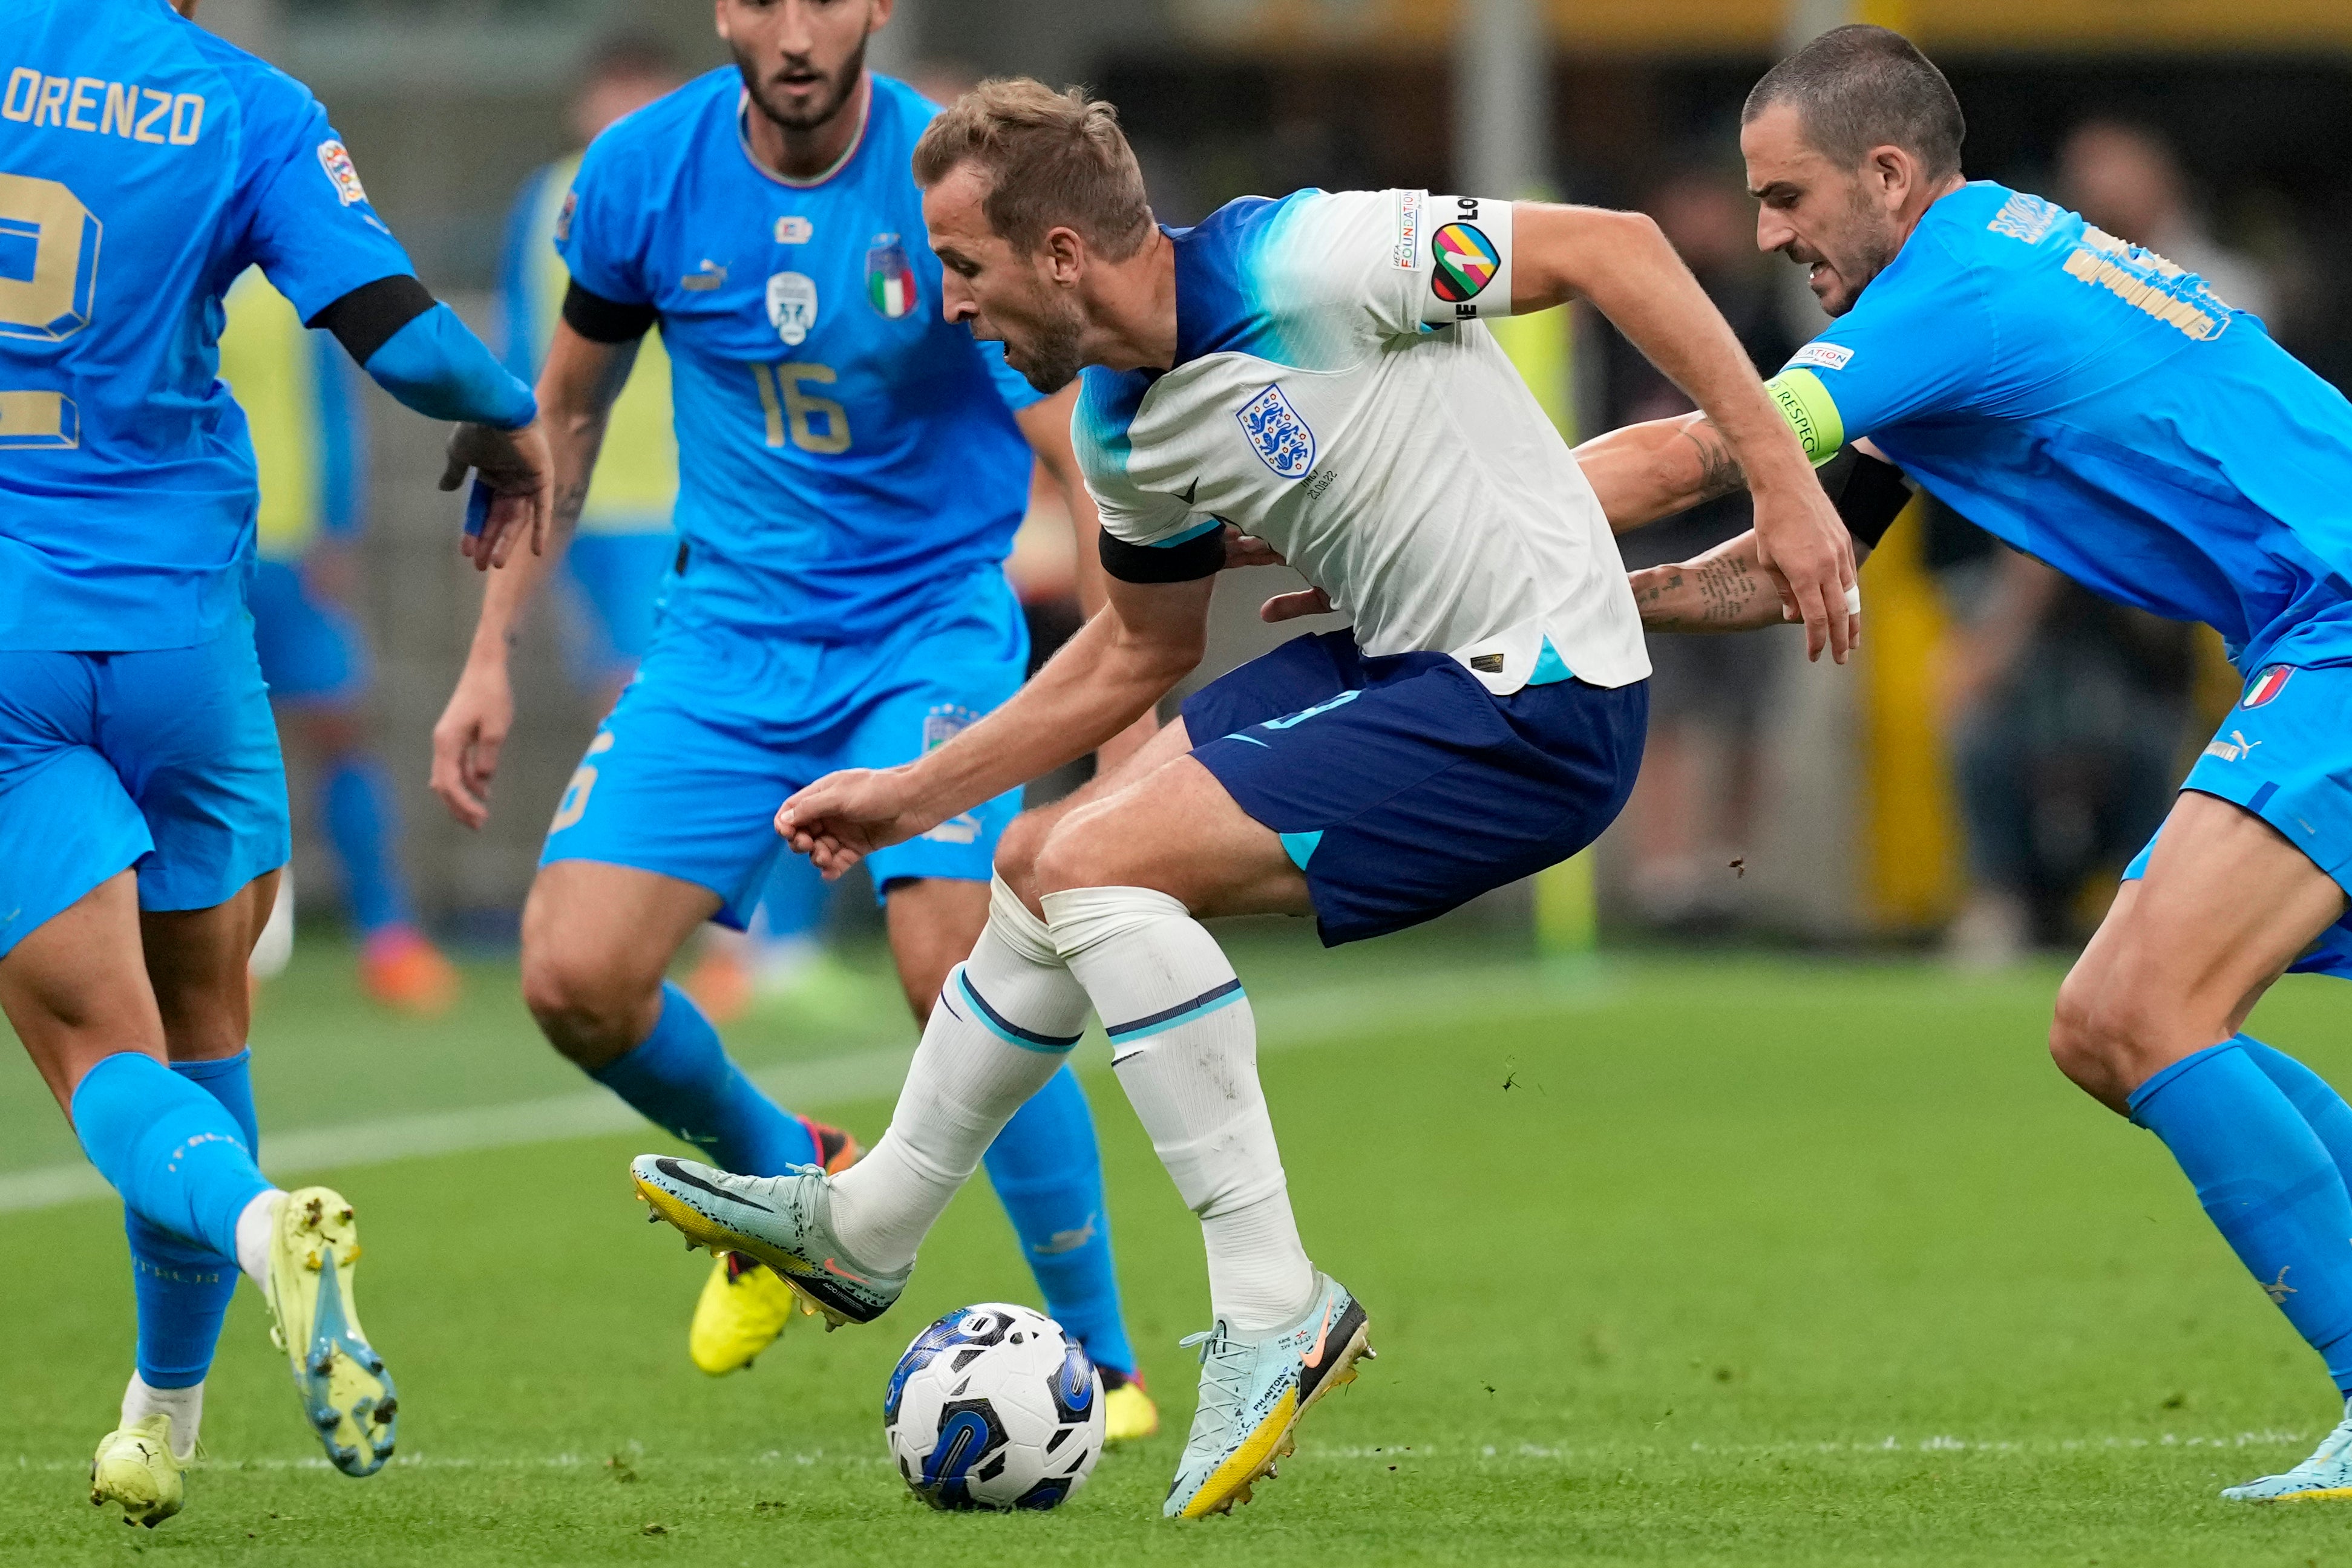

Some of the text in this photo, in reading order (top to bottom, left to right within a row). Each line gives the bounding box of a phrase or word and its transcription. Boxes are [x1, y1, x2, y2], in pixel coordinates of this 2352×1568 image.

[1401, 191, 1413, 268] FOUNDATION
[1458, 197, 1478, 220] LO
[1456, 304, 1477, 320] E
[750, 362, 853, 455] 16
[1777, 391, 1815, 454] RESPECT
[1253, 1373, 1287, 1411] PHANTOM
